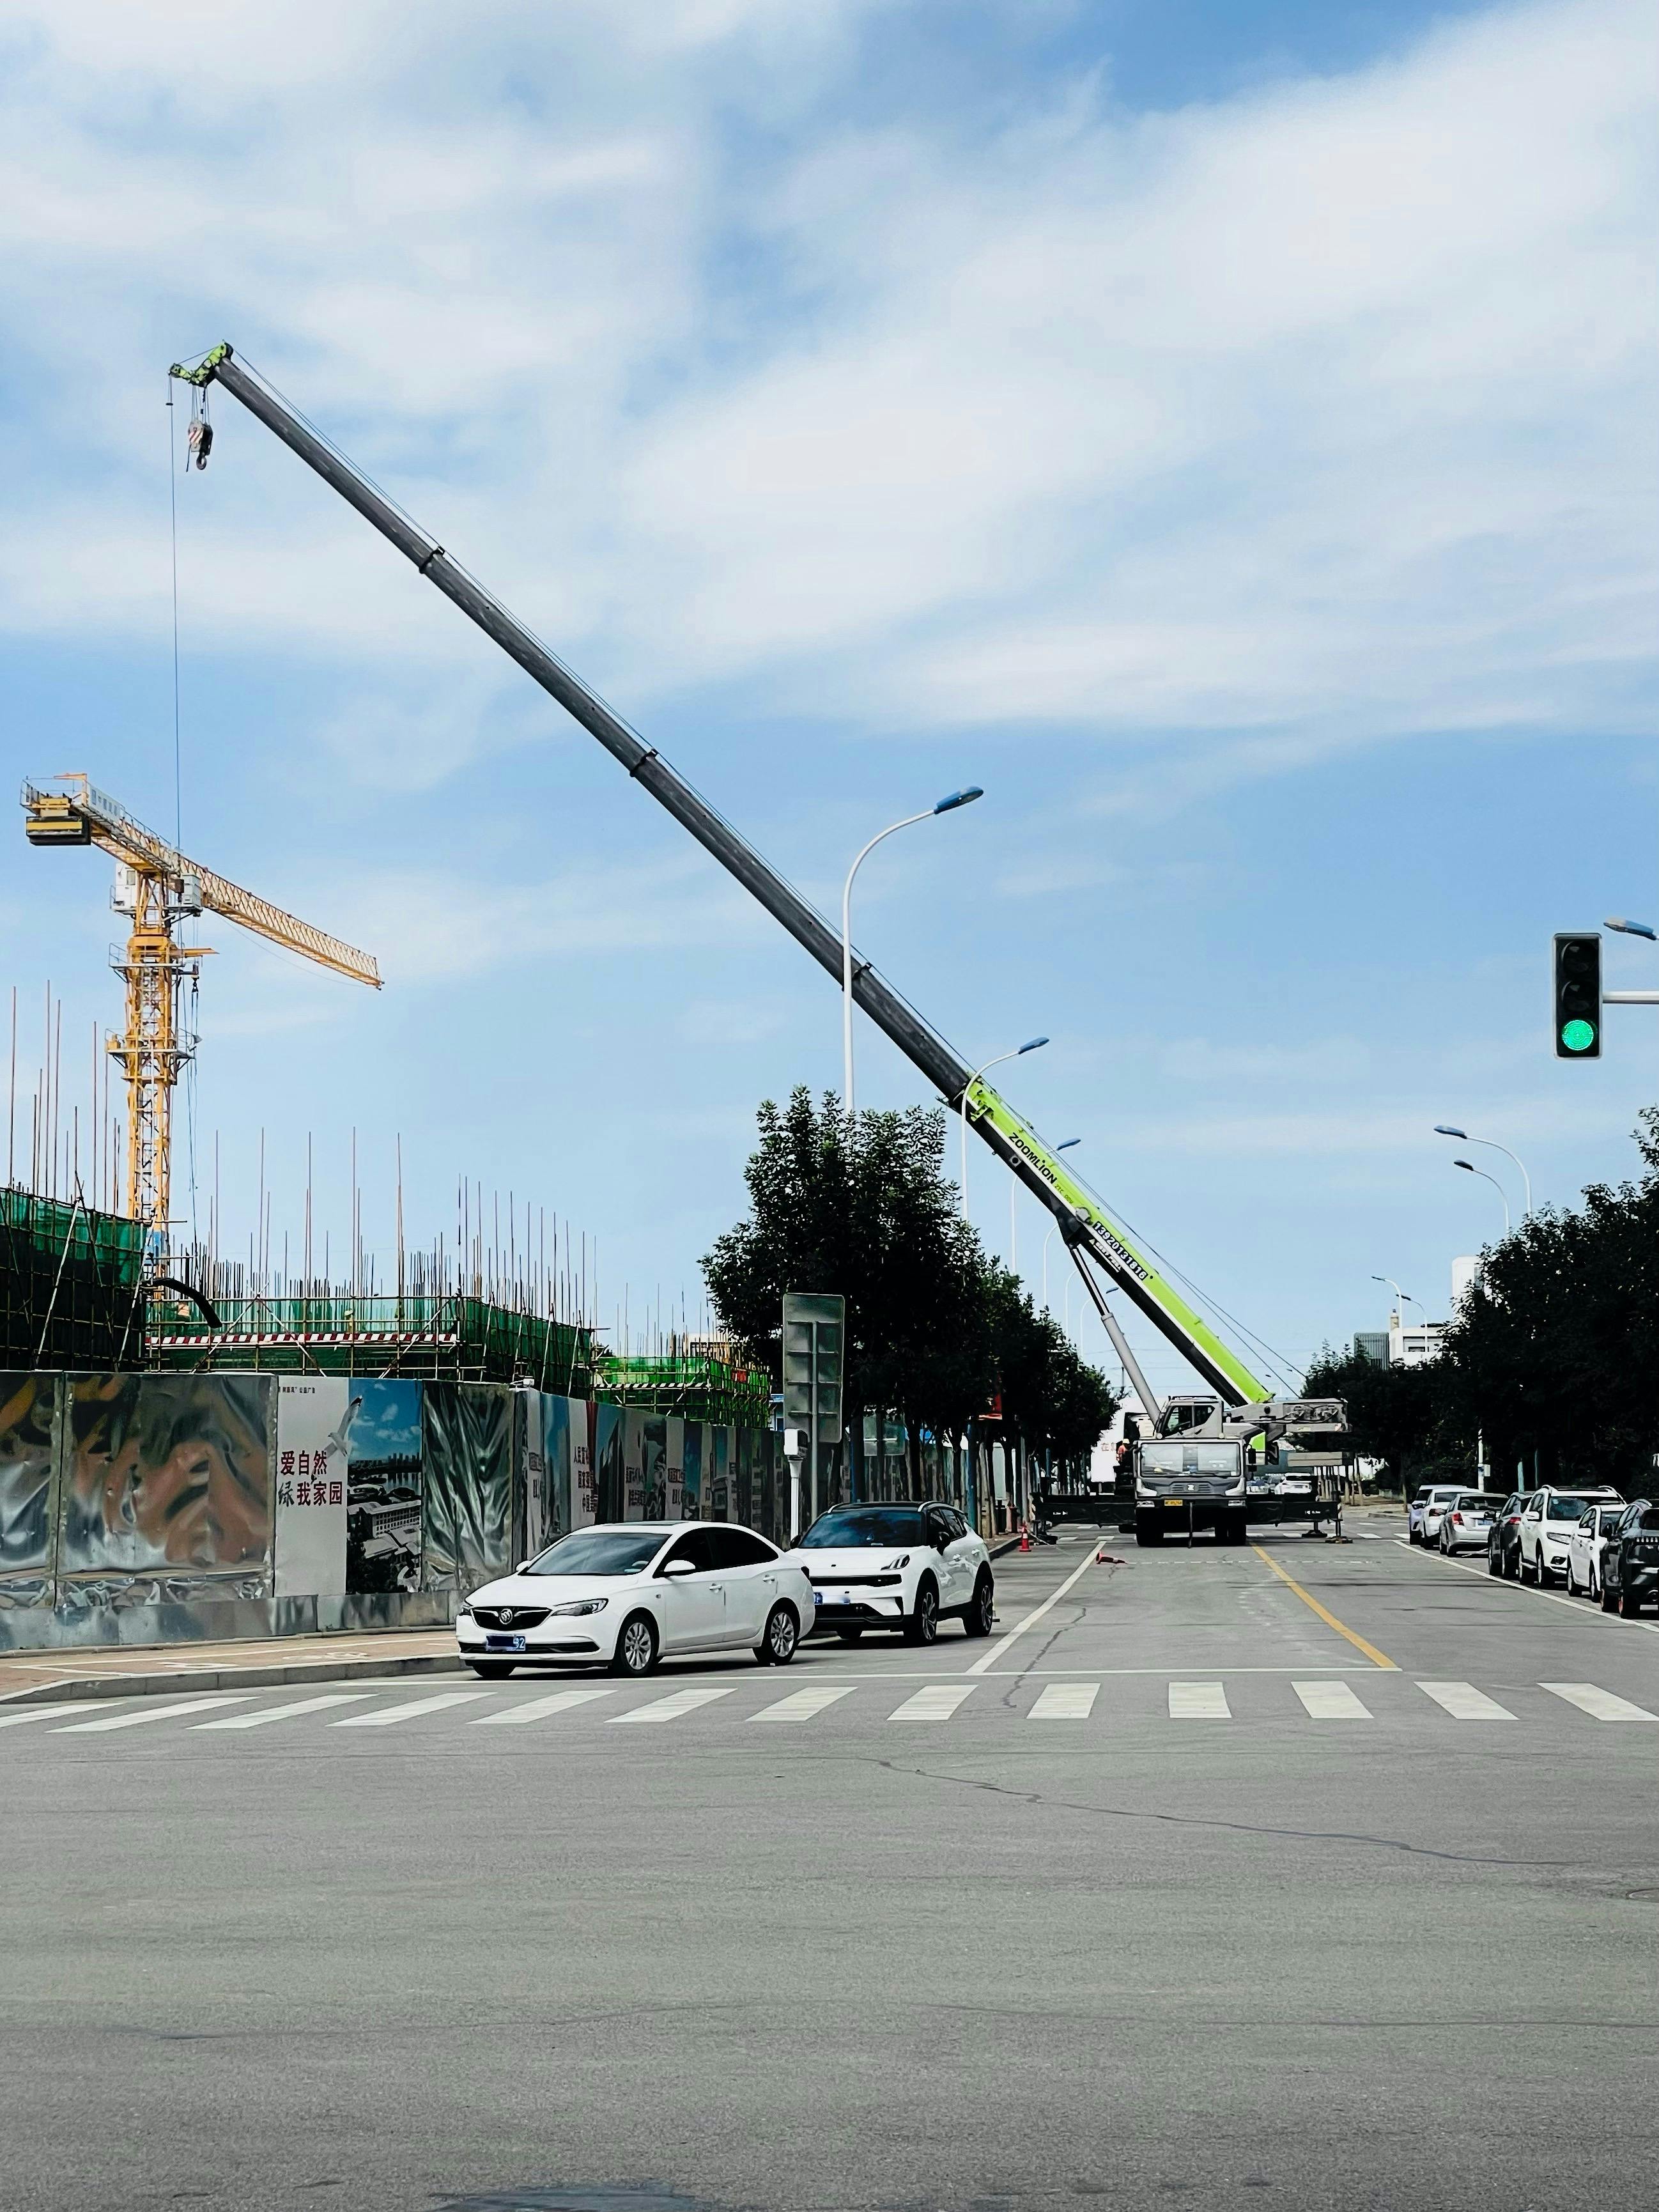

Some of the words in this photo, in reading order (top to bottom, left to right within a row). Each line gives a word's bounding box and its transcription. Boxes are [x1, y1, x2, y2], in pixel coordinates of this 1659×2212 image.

[1008, 1132, 1057, 1184] ZOOMLION
[1093, 1221, 1147, 1280] 13920131816
[281, 1450, 327, 1476] 爱自然
[278, 1481, 343, 1507] 绿我家园
